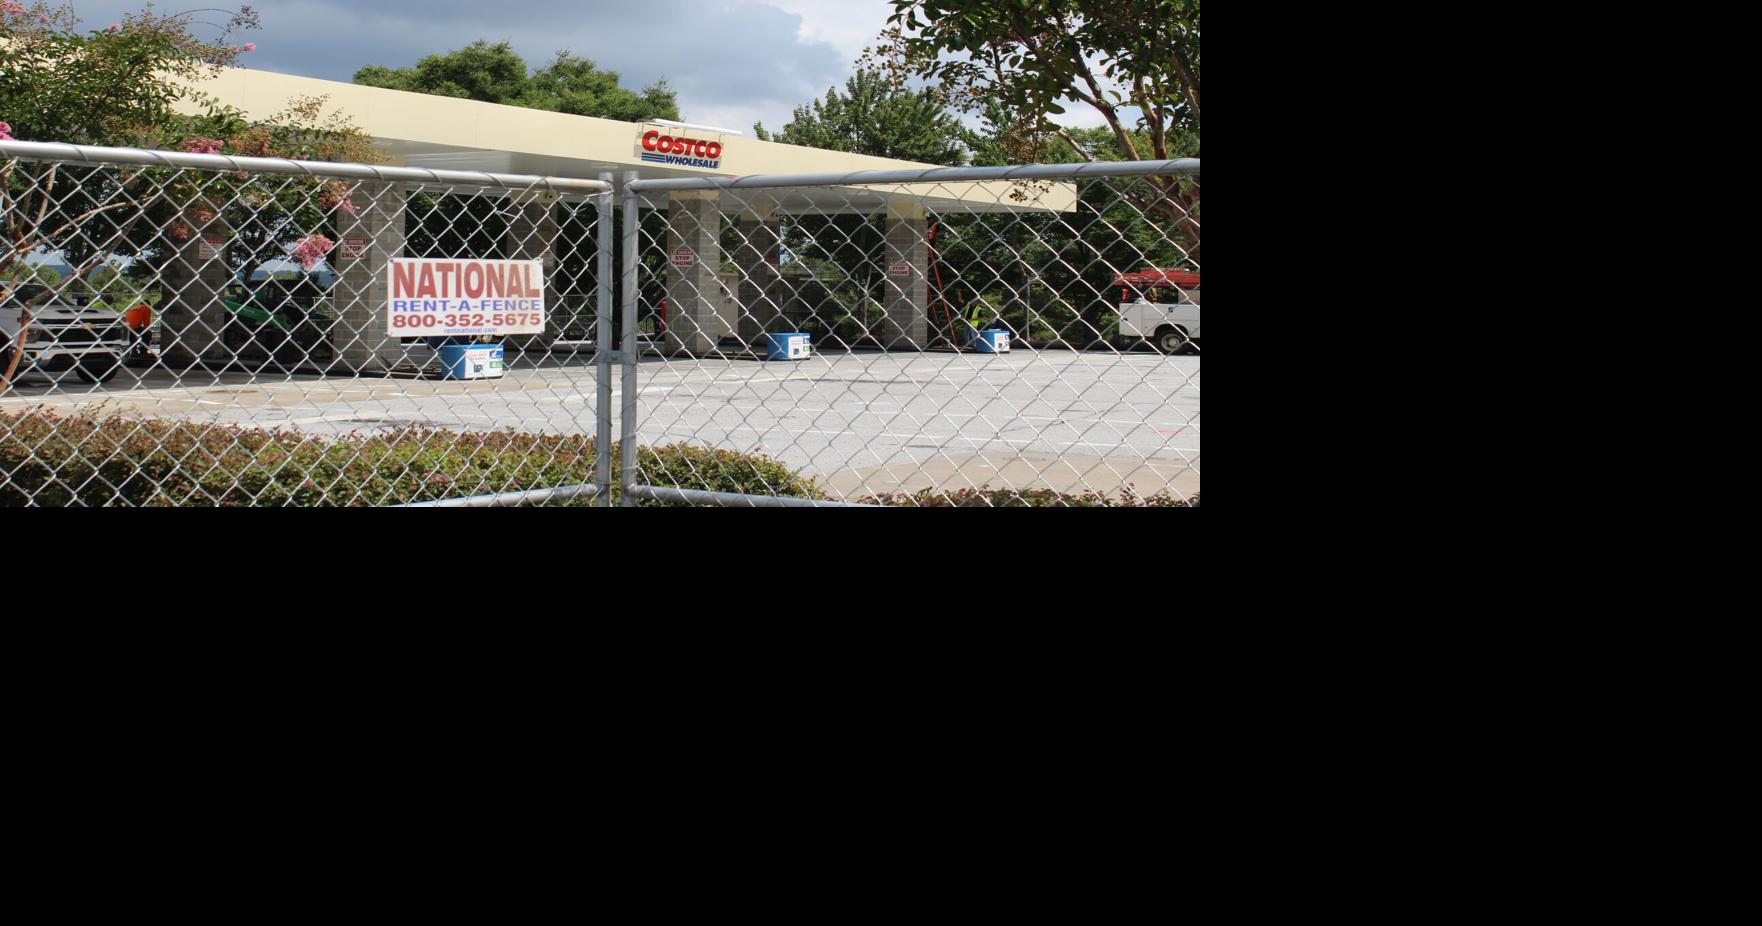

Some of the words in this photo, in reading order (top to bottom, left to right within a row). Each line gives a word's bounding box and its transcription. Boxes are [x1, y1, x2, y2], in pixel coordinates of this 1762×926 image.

[642, 130, 721, 158] COSTCO
[665, 155, 719, 168] WHOLESALE
[393, 262, 540, 299] NATIONAL
[393, 300, 541, 312] RENT-A-FENCE
[392, 313, 541, 328] 800-352-5675
